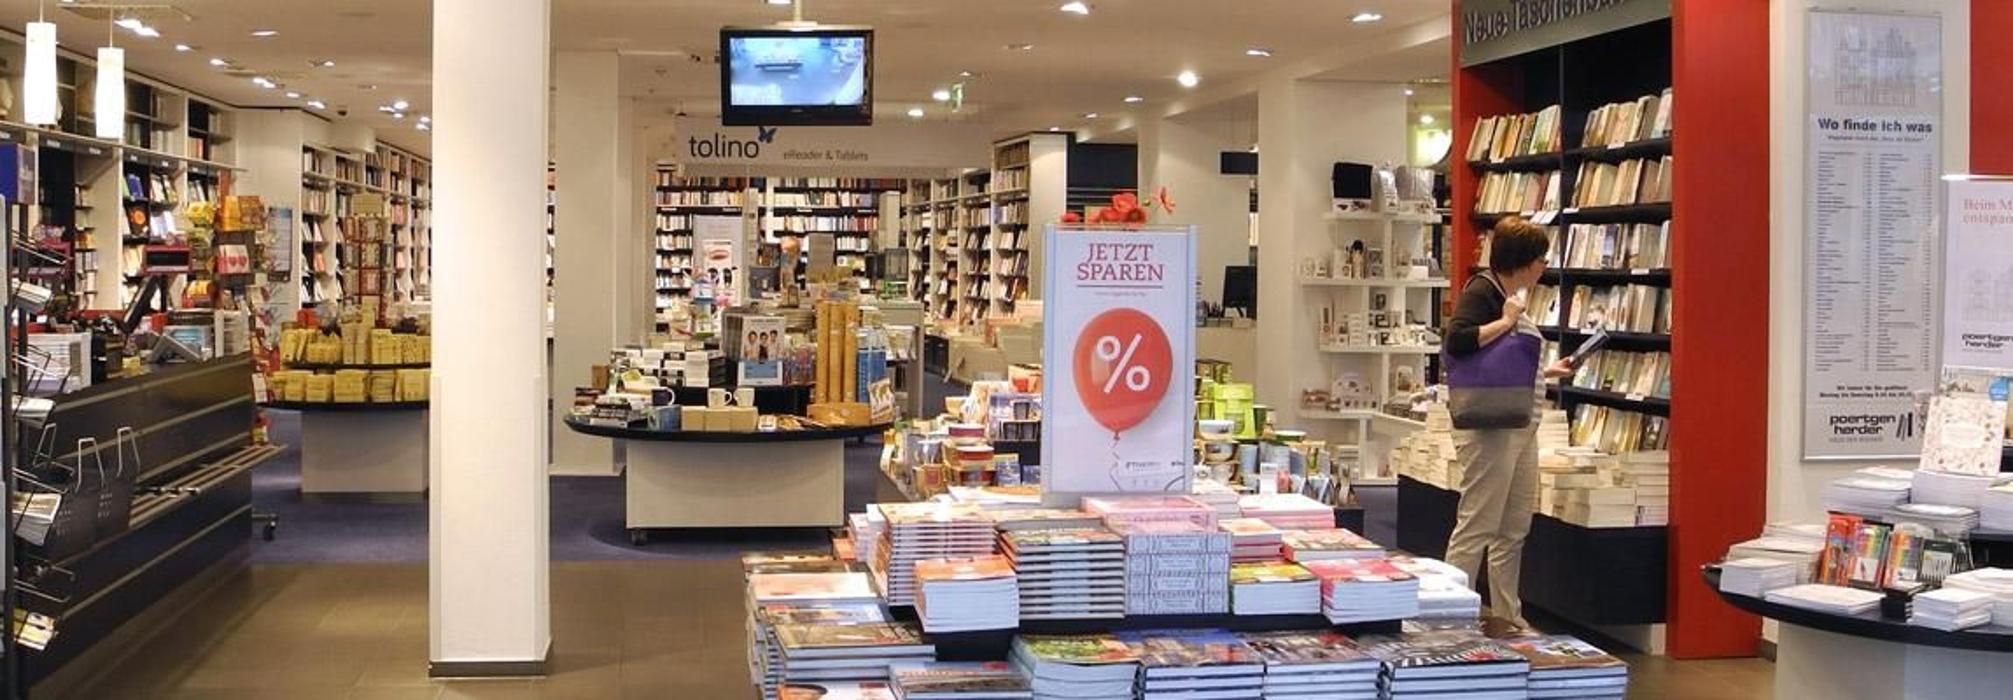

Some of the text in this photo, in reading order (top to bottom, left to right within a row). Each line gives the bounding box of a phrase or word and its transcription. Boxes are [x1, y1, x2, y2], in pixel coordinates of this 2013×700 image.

[1818, 118, 1838, 130] Wo
[1843, 118, 1877, 131] finde
[1905, 123, 1932, 132] was
[689, 133, 759, 158] tolino
[825, 151, 834, 160] &
[1087, 243, 1153, 263] JETZT
[1077, 263, 1164, 281] SPAREN
[1830, 415, 1896, 425] poertgen
[1834, 426, 1882, 434] herder
